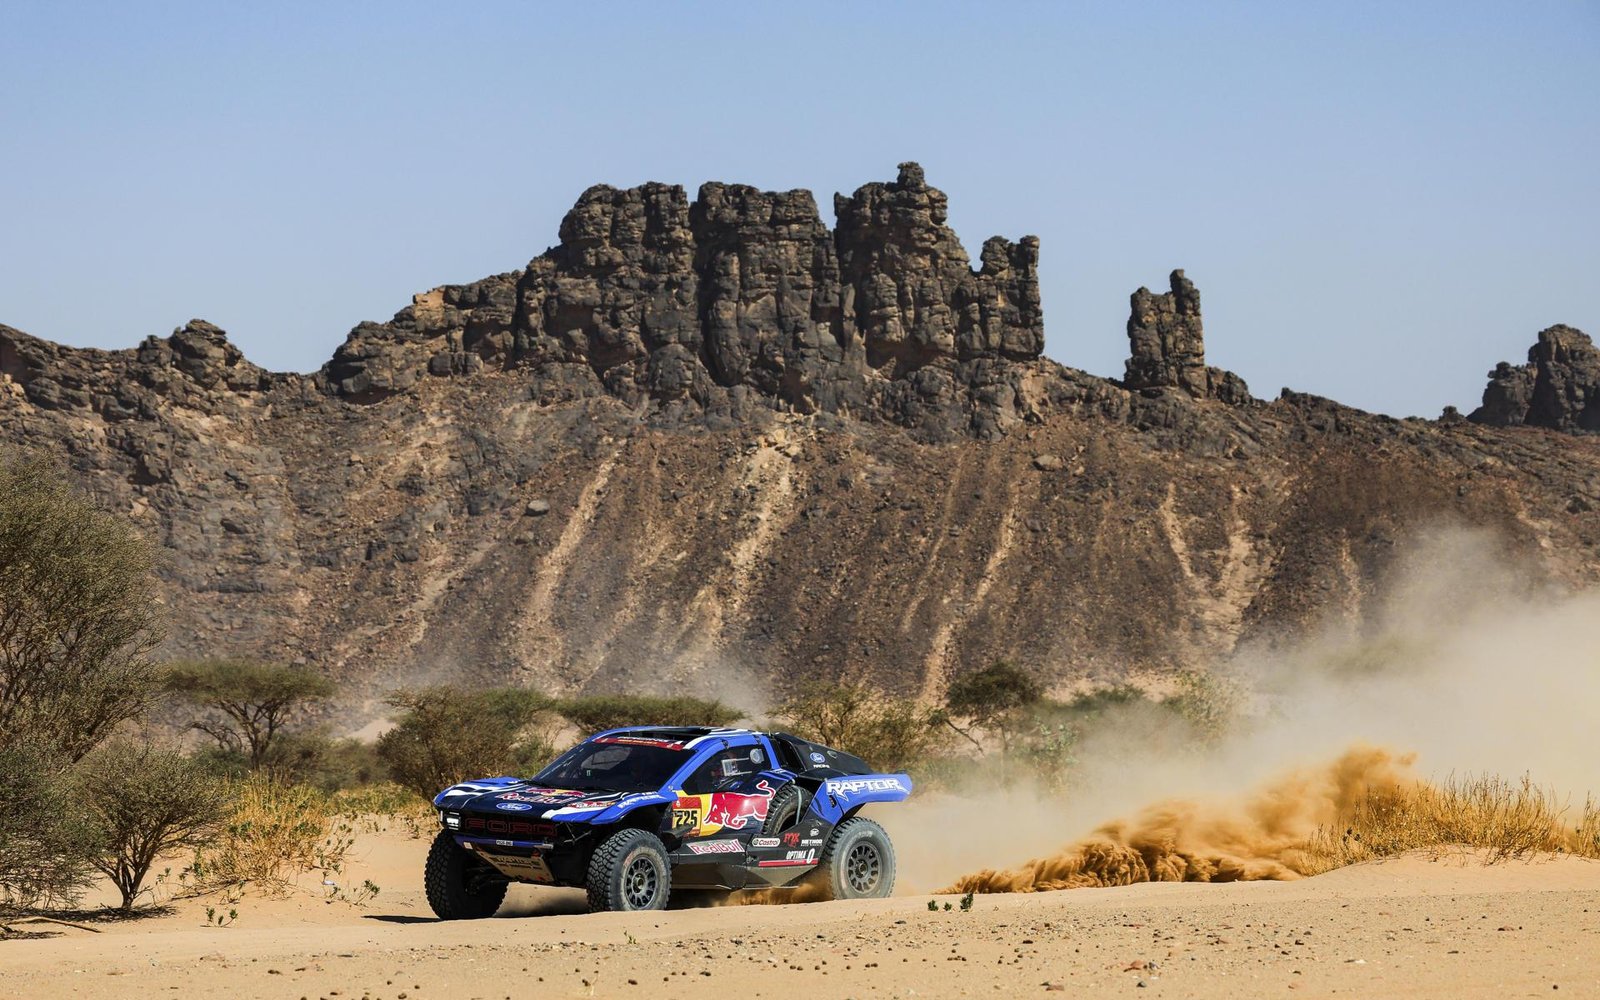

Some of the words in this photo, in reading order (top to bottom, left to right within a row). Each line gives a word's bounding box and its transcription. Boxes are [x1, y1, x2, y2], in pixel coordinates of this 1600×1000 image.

[826, 779, 910, 801] RAPTOR
[464, 818, 558, 836] FORD
[674, 810, 698, 828] 225
[786, 850, 807, 860] OPTIMA
